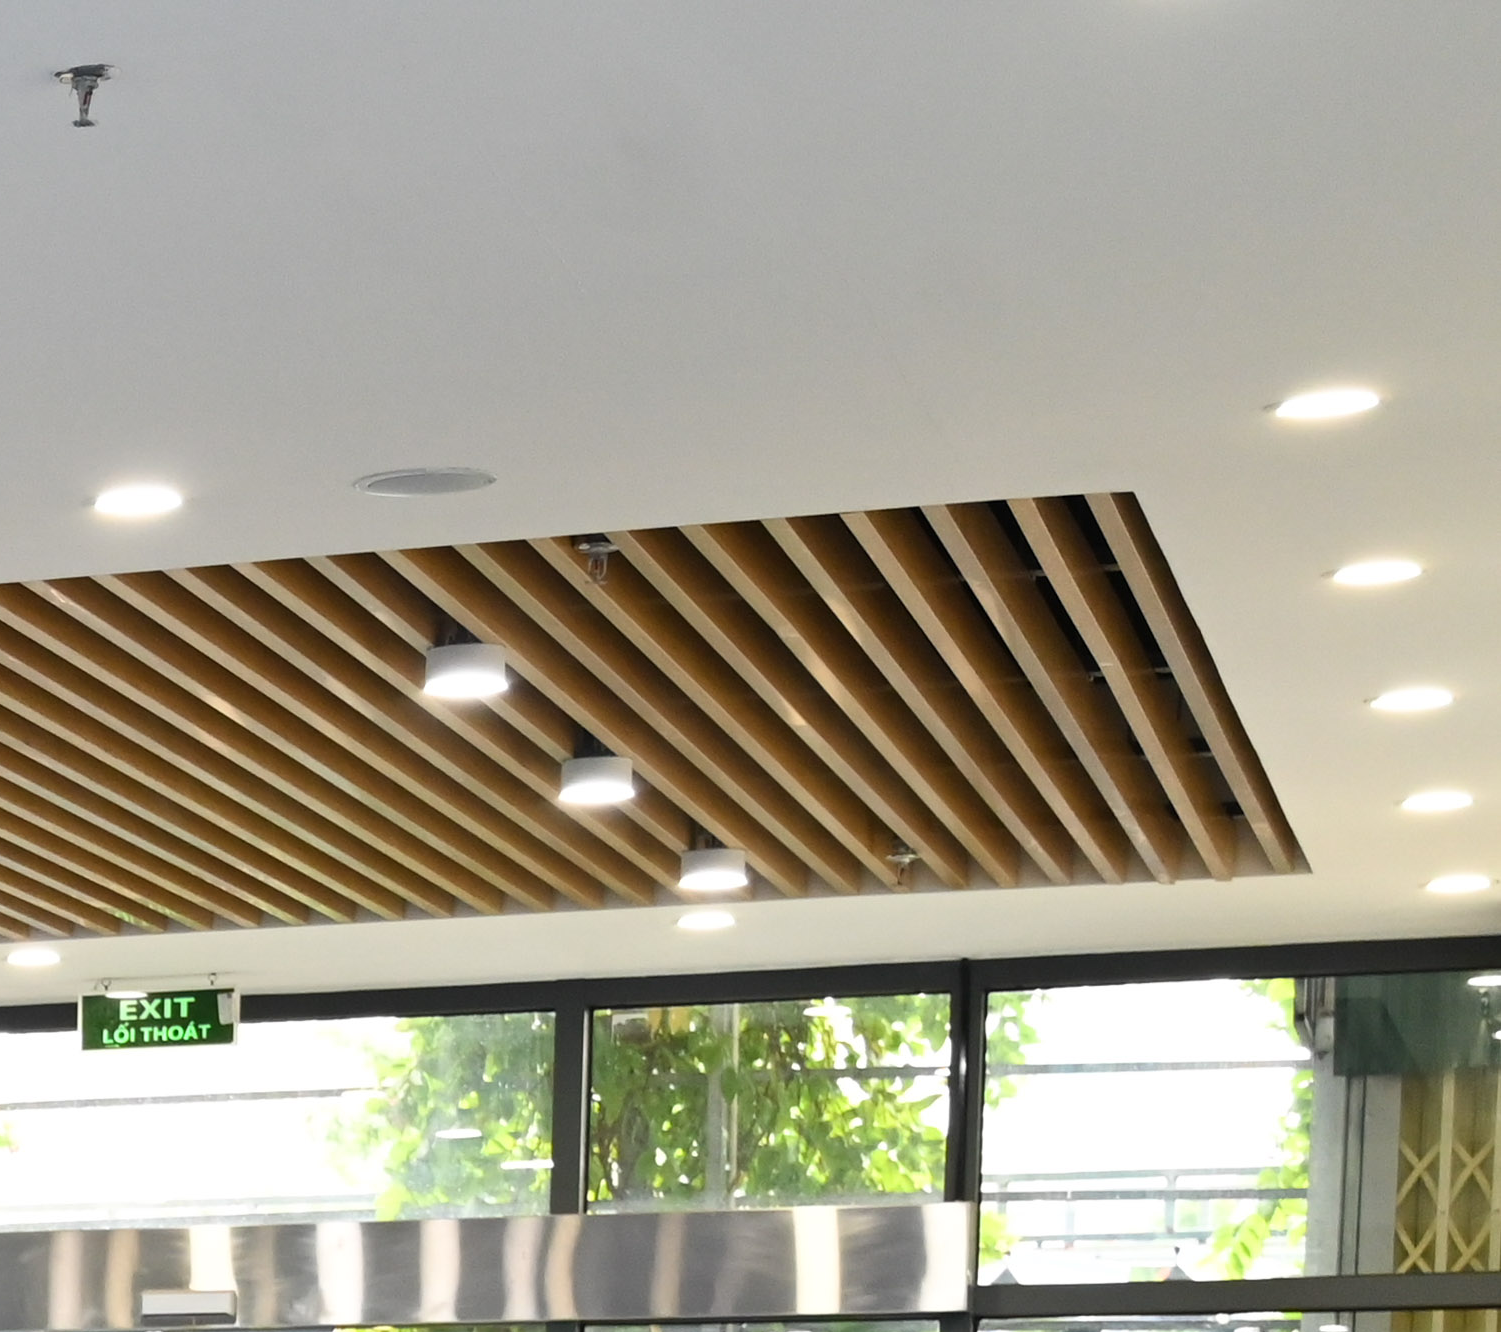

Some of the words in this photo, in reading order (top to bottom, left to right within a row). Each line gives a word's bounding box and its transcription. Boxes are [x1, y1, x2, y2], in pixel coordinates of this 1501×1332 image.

[119, 997, 195, 1021] EXIT
[102, 1022, 136, 1044] LỐI
[140, 1020, 211, 1042] THOÁT
